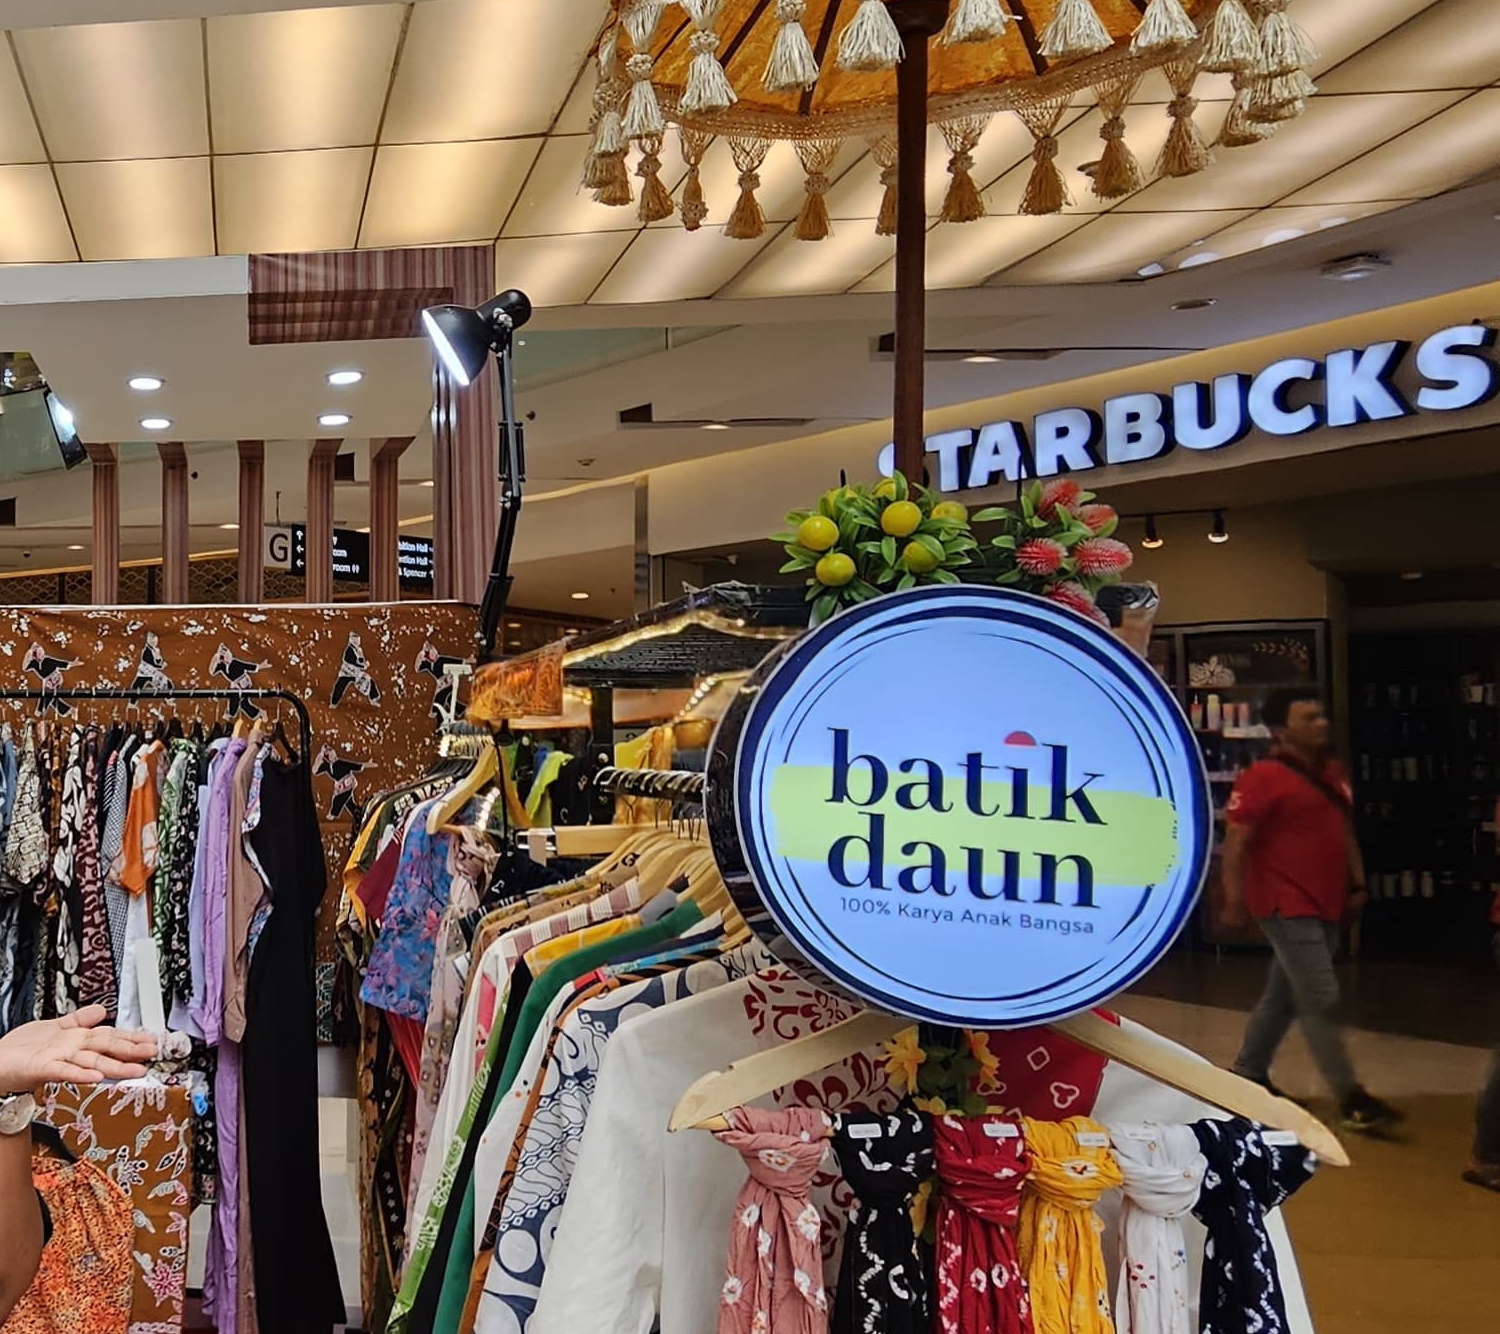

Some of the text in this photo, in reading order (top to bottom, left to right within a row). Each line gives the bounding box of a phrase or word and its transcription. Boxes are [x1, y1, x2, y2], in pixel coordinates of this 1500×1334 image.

[878, 325, 1492, 492] TARBUCKS
[269, 533, 288, 562] G
[824, 727, 1109, 827] batik
[827, 811, 1101, 909] daun
[841, 897, 1095, 935] 100% Karya Anak Bangsa
